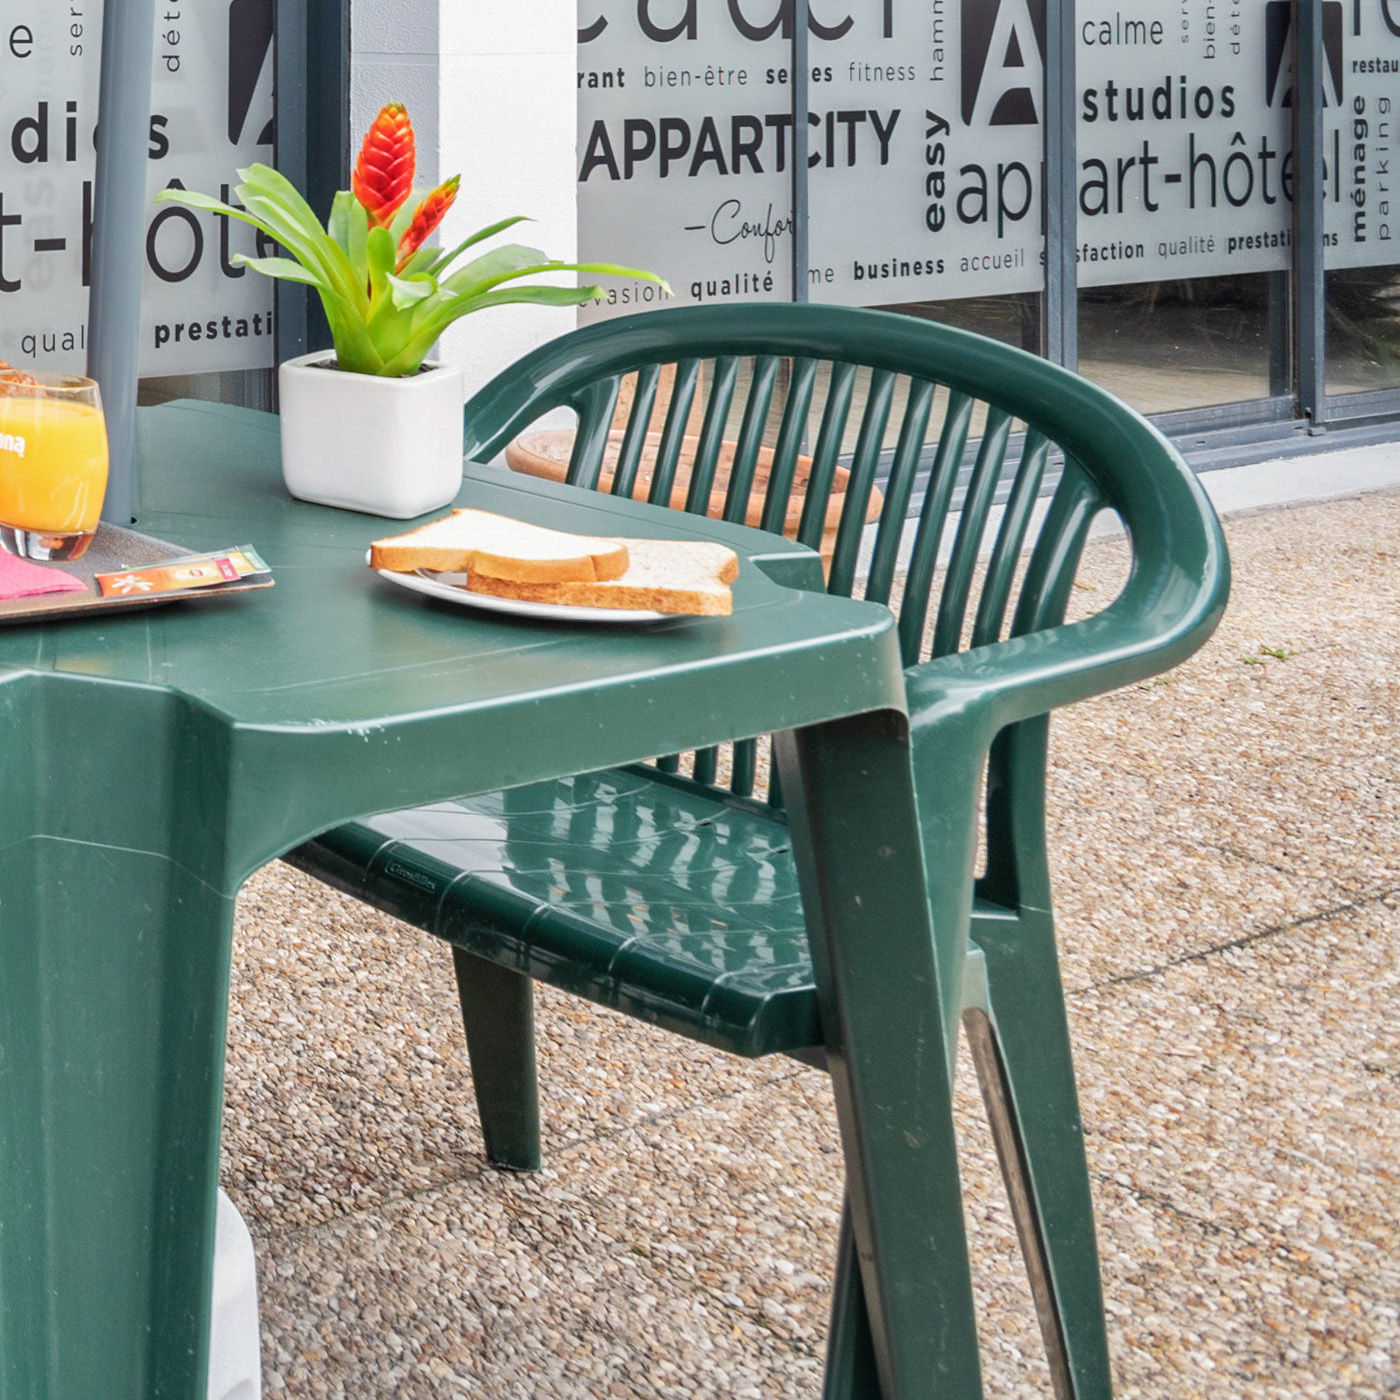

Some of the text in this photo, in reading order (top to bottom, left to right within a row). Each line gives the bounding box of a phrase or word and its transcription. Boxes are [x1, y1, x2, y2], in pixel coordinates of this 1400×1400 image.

[1082, 12, 1164, 45] calme
[644, 64, 748, 88] bien-être
[848, 61, 915, 82] fitness
[1082, 75, 1235, 123] studios
[578, 109, 902, 182] APPARTCITY
[926, 110, 950, 232] easy
[1350, 95, 1369, 242] ménage
[1375, 97, 1392, 241] parking
[691, 271, 774, 301] qualité
[853, 257, 945, 281] business
[960, 248, 1024, 273] accueil
[1158, 234, 1215, 259] qualité
[1228, 228, 1339, 252] prestatins
[21, 324, 88, 358] qual
